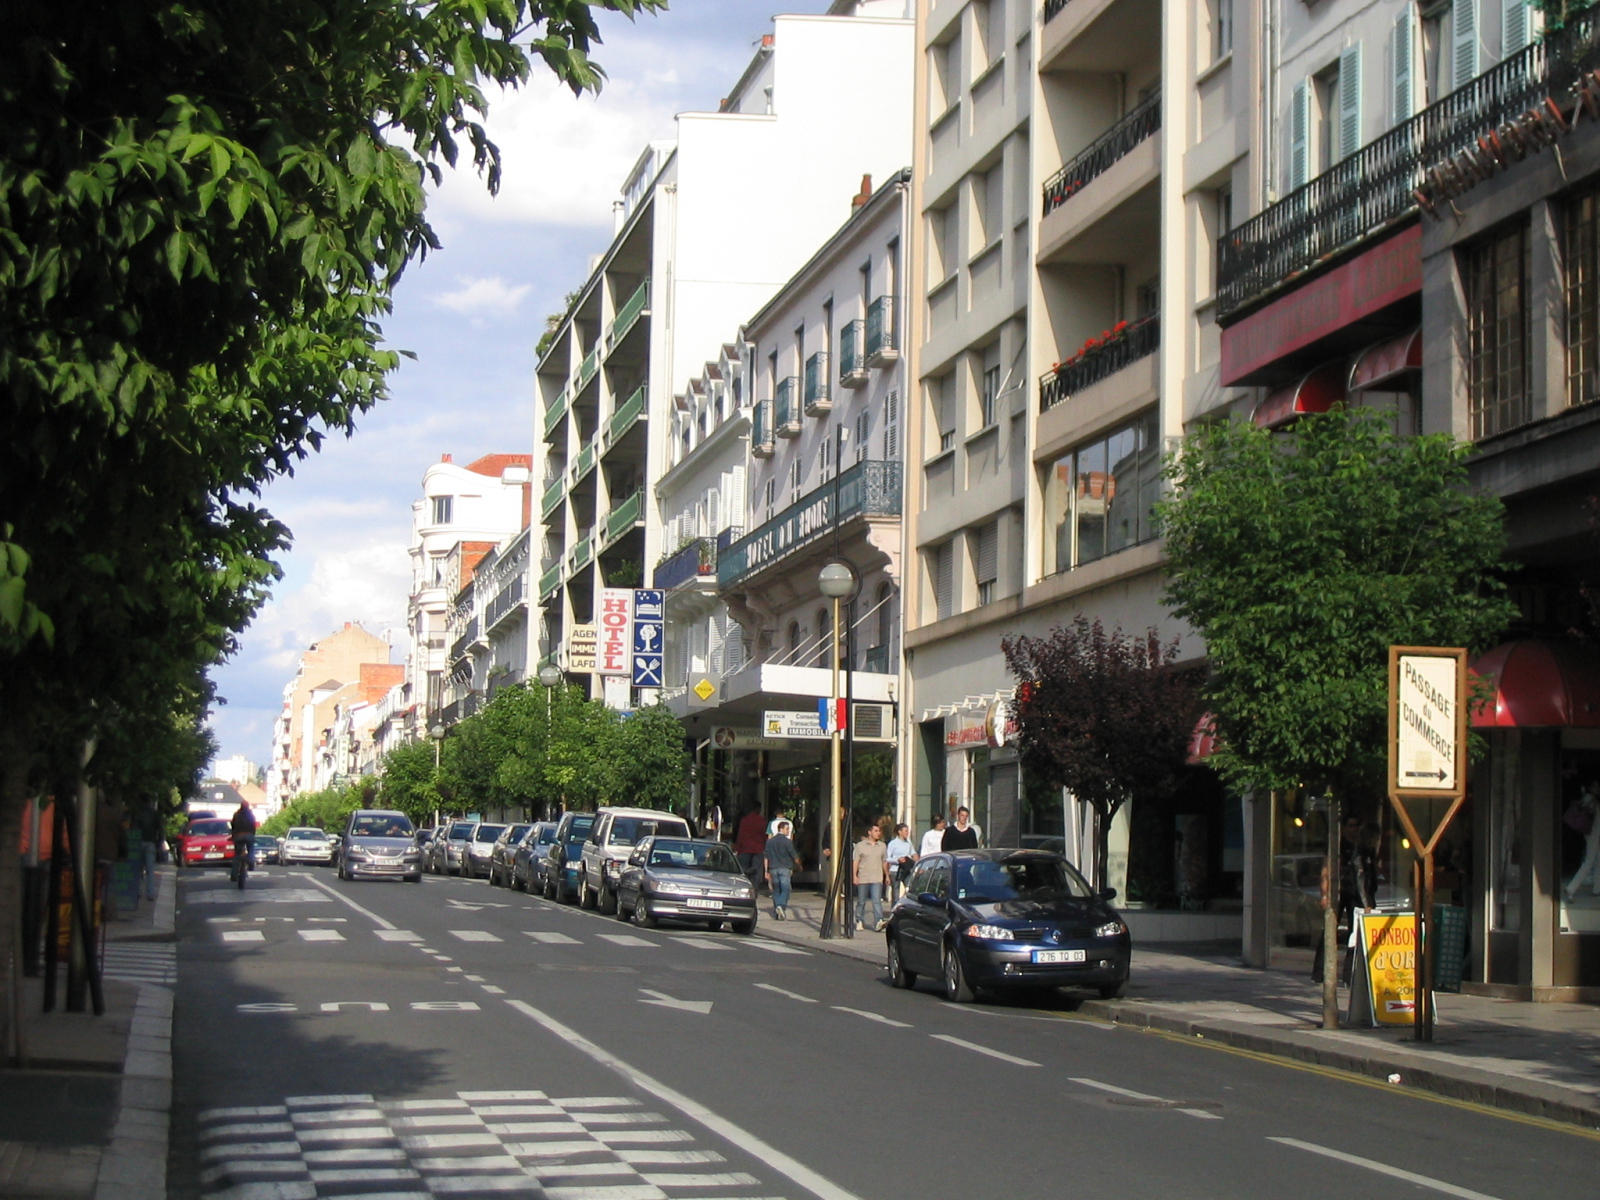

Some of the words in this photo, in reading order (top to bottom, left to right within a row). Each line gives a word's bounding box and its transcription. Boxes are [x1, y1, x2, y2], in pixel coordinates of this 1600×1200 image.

[603, 599, 627, 669] HOTEL
[1405, 660, 1450, 719] PASSAGE
[1423, 703, 1432, 720] du
[1403, 702, 1452, 763] COMMERCE
[1039, 950, 1056, 962] 276
[1060, 950, 1069, 961] TQ
[1074, 950, 1084, 961] 03
